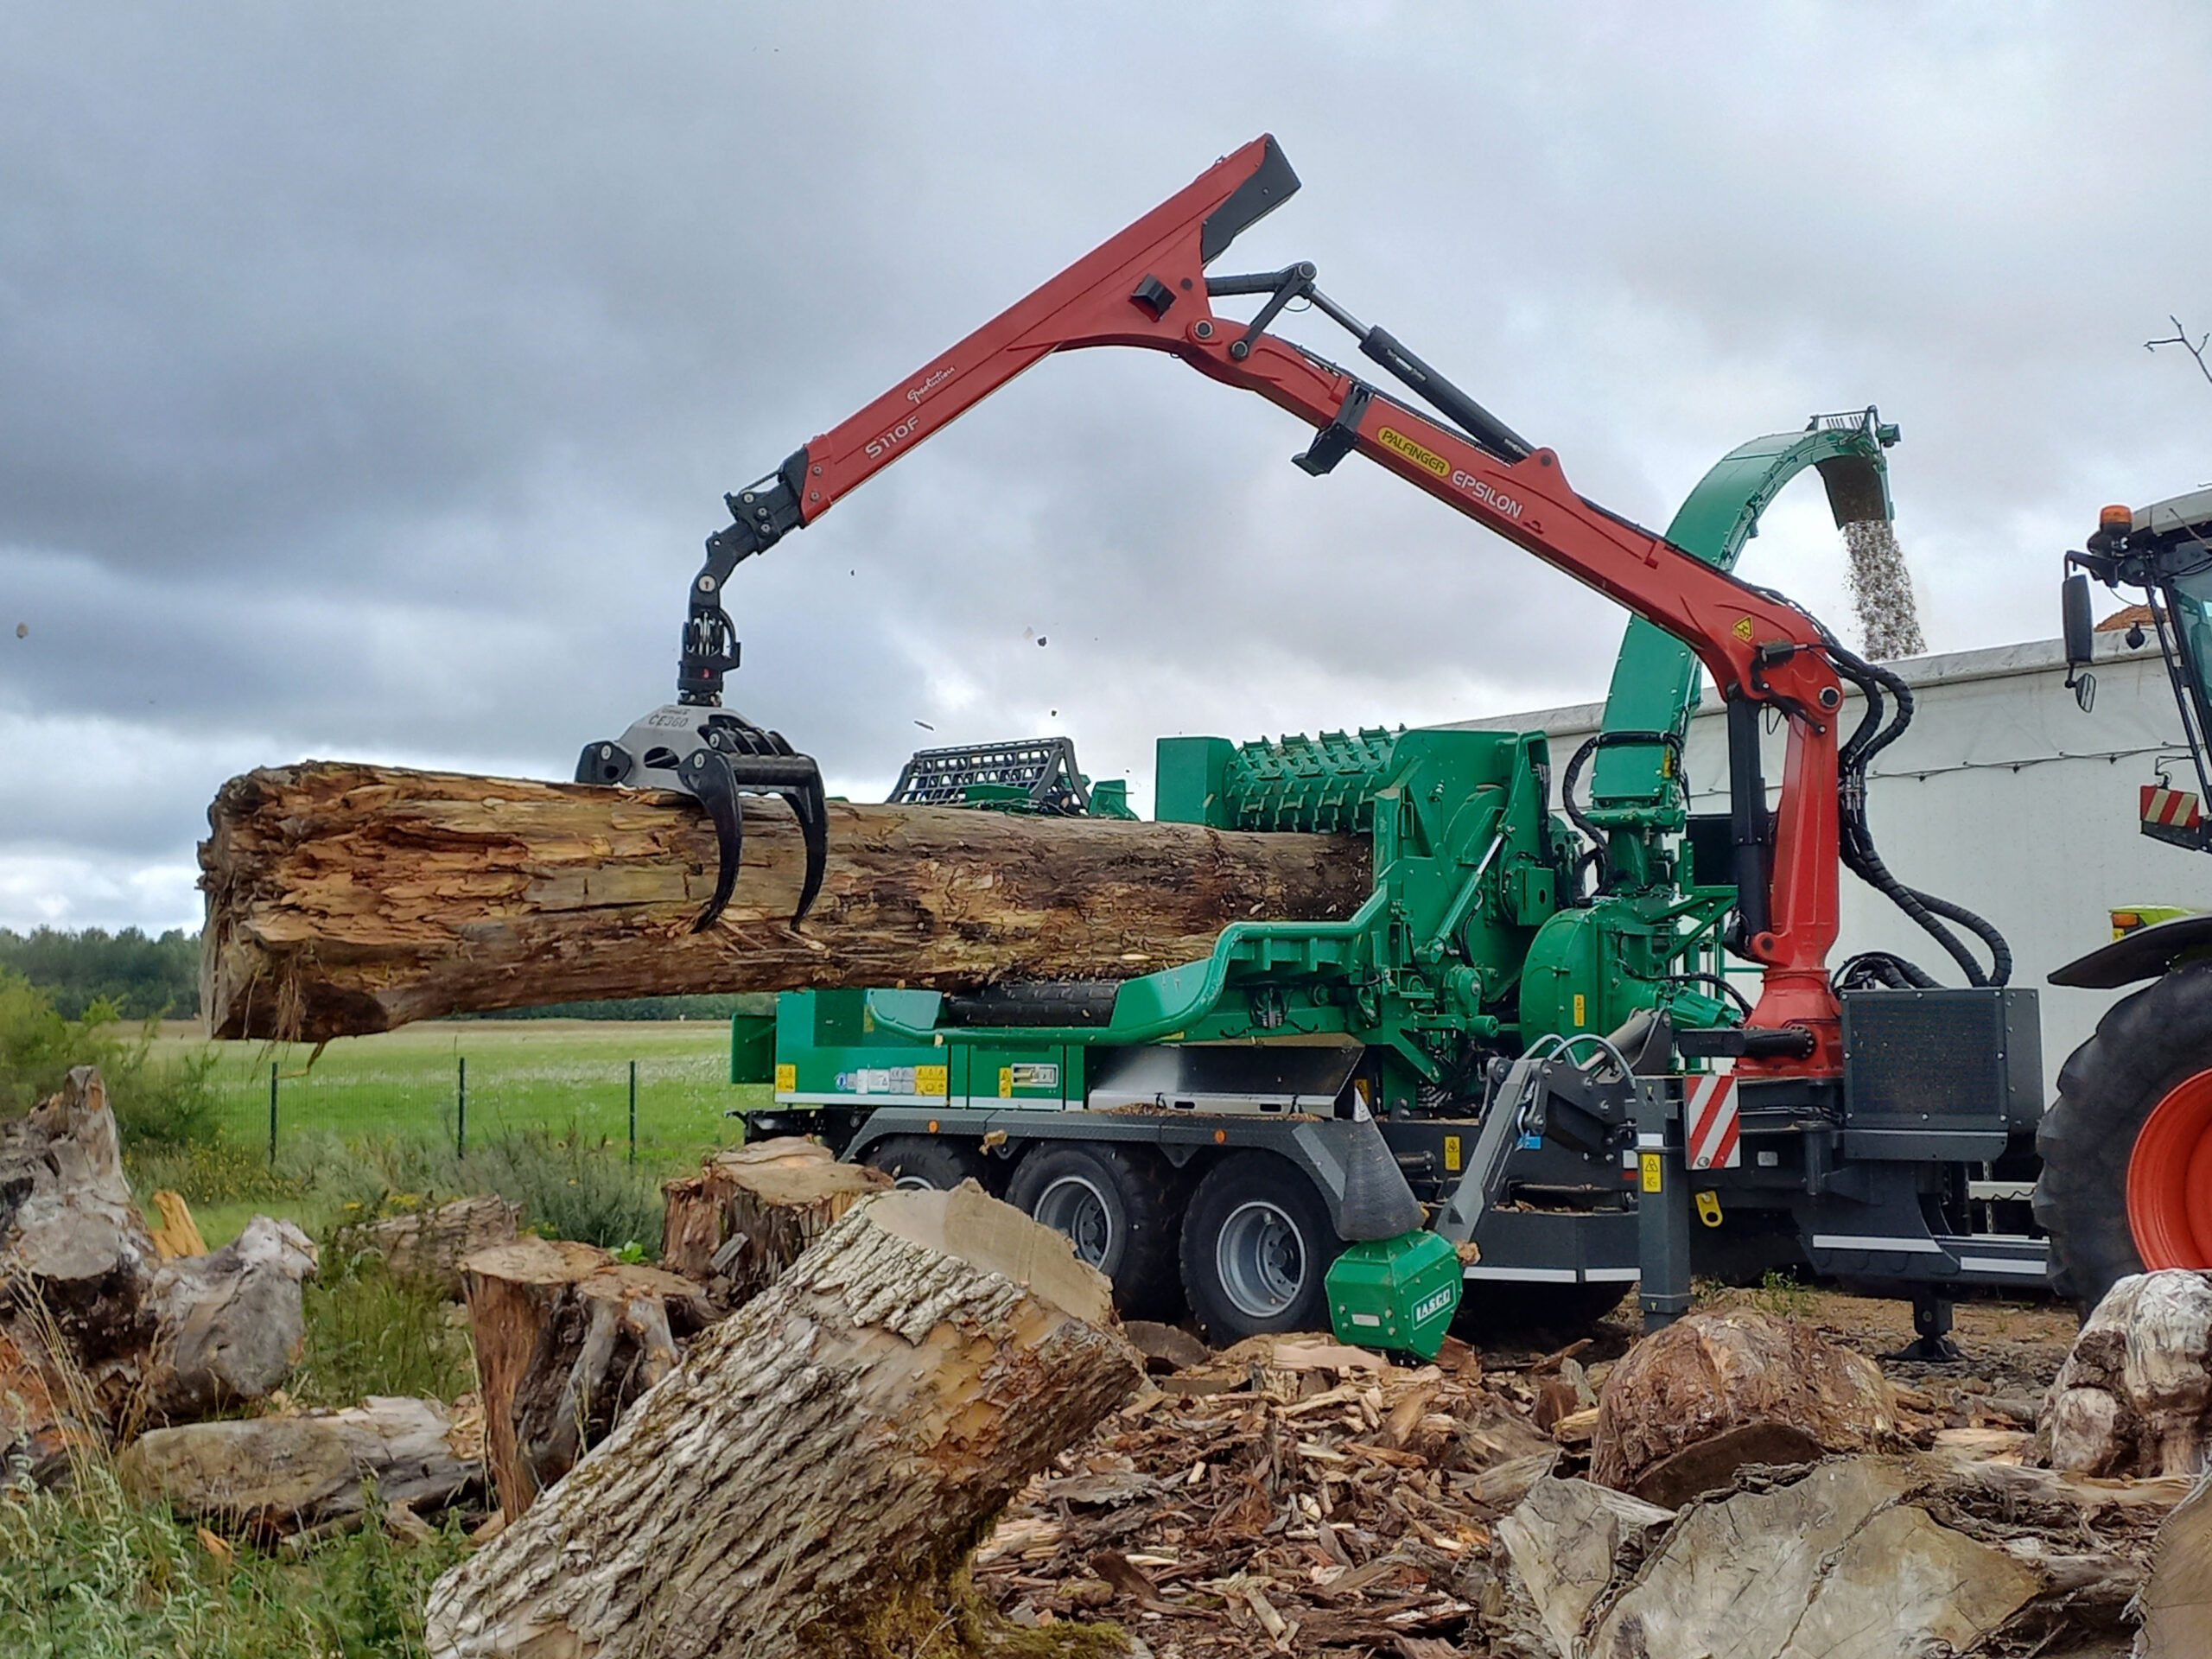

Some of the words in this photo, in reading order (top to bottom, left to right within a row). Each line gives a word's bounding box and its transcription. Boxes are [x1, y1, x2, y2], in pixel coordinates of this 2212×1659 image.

[865, 416, 918, 459] S110F
[1382, 429, 1446, 474] PALFINGER
[1452, 470, 1522, 519] EPSILON
[1416, 1288, 1451, 1322] LASCO
